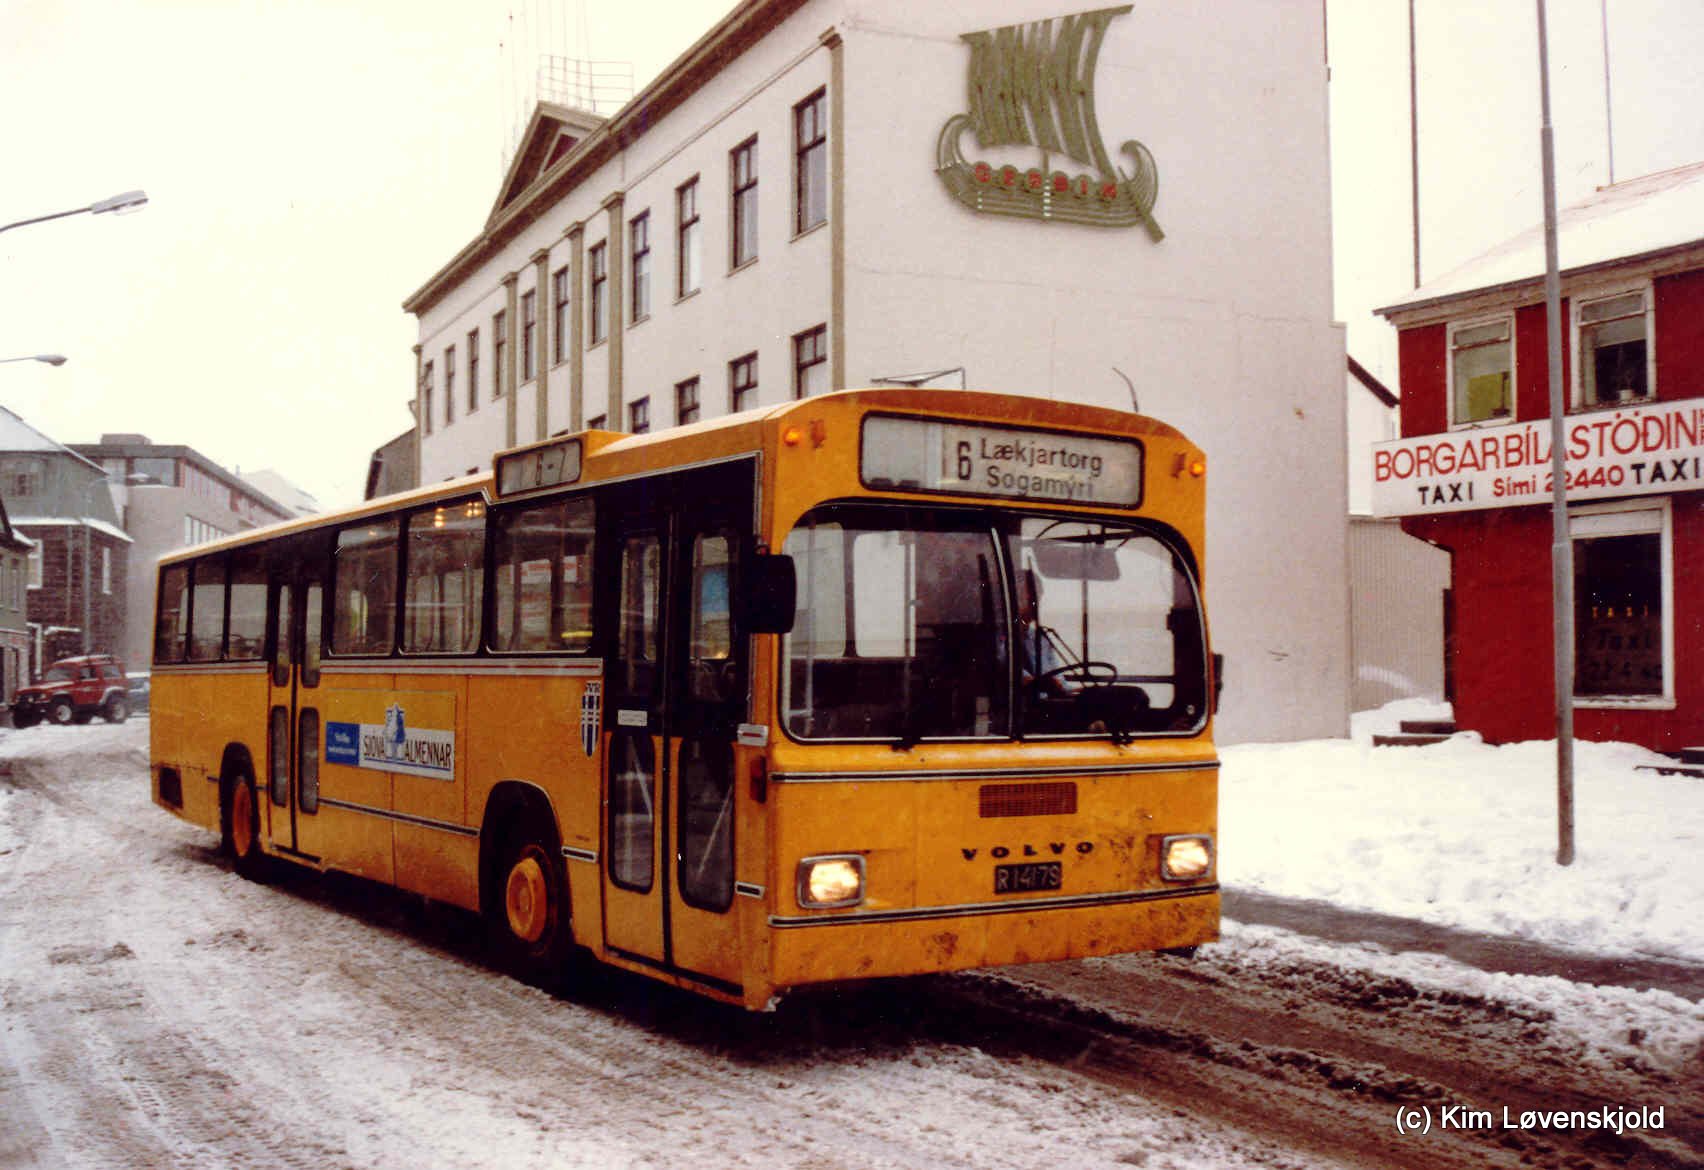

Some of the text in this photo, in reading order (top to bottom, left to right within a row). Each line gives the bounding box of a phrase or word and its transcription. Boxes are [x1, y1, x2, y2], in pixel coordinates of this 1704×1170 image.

[957, 440, 972, 480] 6
[980, 437, 1104, 477] Lækjartorg
[986, 465, 1096, 499] Sogamýri
[1417, 457, 1700, 506] TAXI Sími 22440 TAXI
[961, 841, 1094, 861] VOLVO
